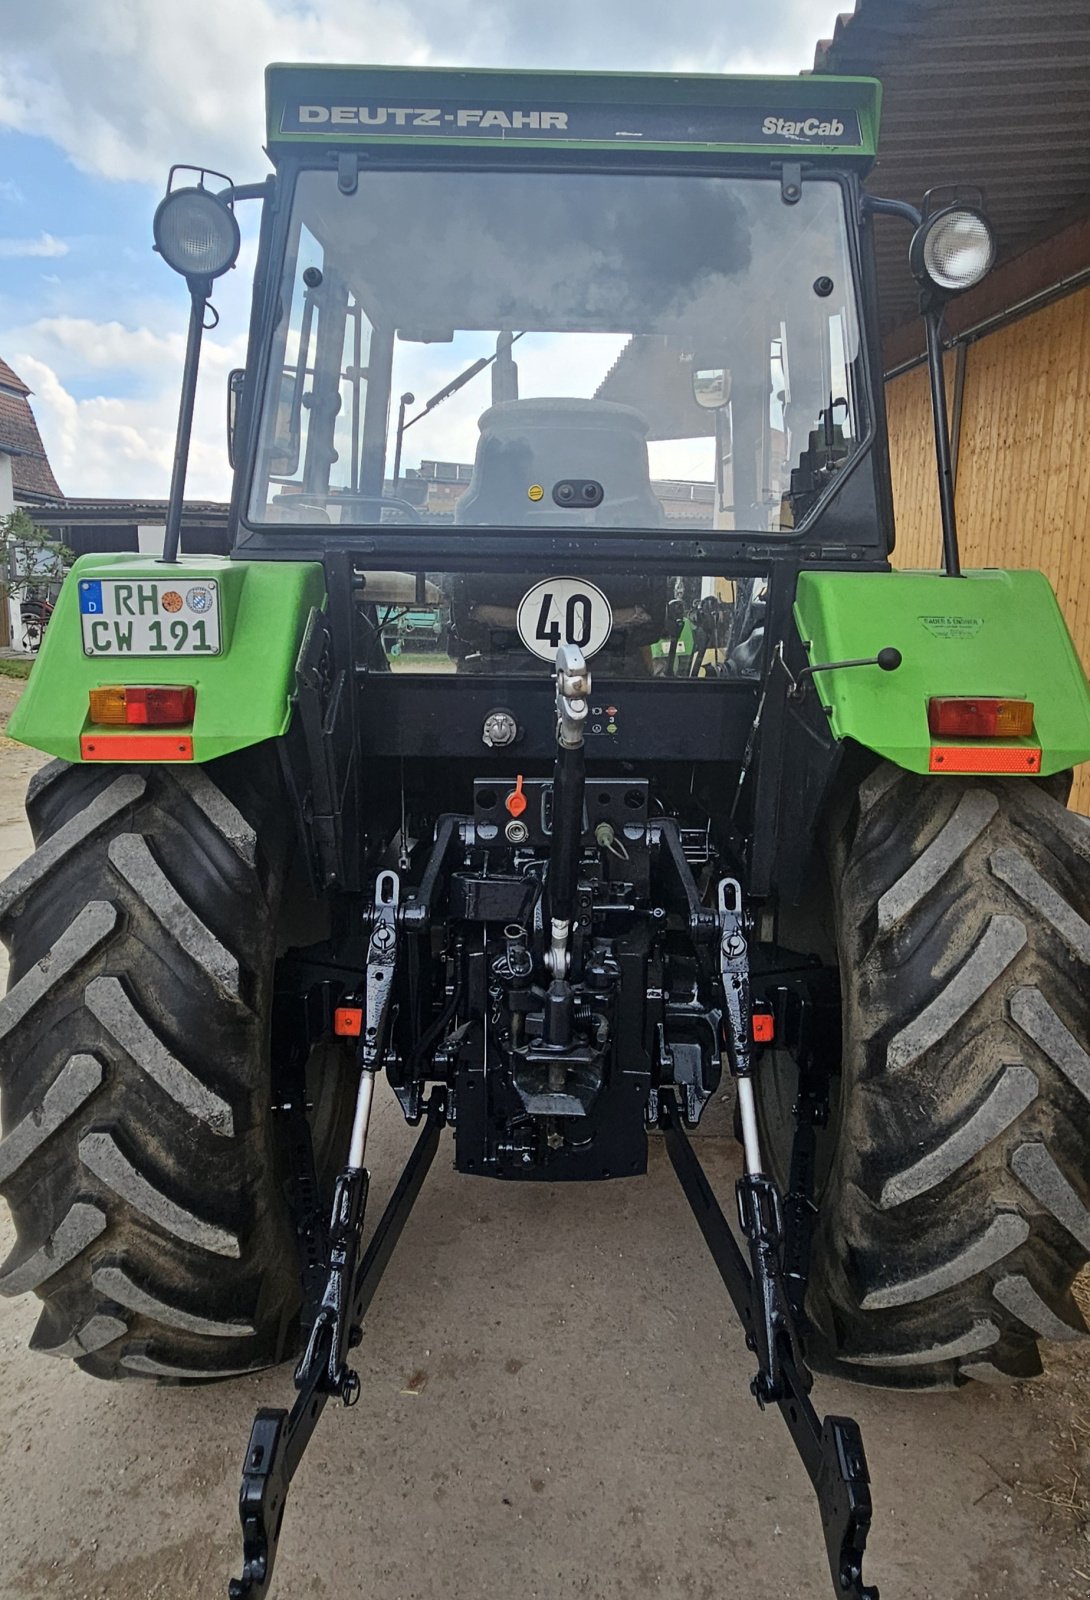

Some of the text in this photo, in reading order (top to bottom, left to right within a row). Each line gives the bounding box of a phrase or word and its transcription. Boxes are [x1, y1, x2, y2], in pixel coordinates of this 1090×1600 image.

[298, 105, 569, 130] DEUTZ-FAHR
[762, 117, 844, 137] StarCab
[88, 601, 97, 612] D
[114, 584, 159, 615] RH
[535, 593, 592, 648] 40
[91, 620, 212, 651] CW 191
